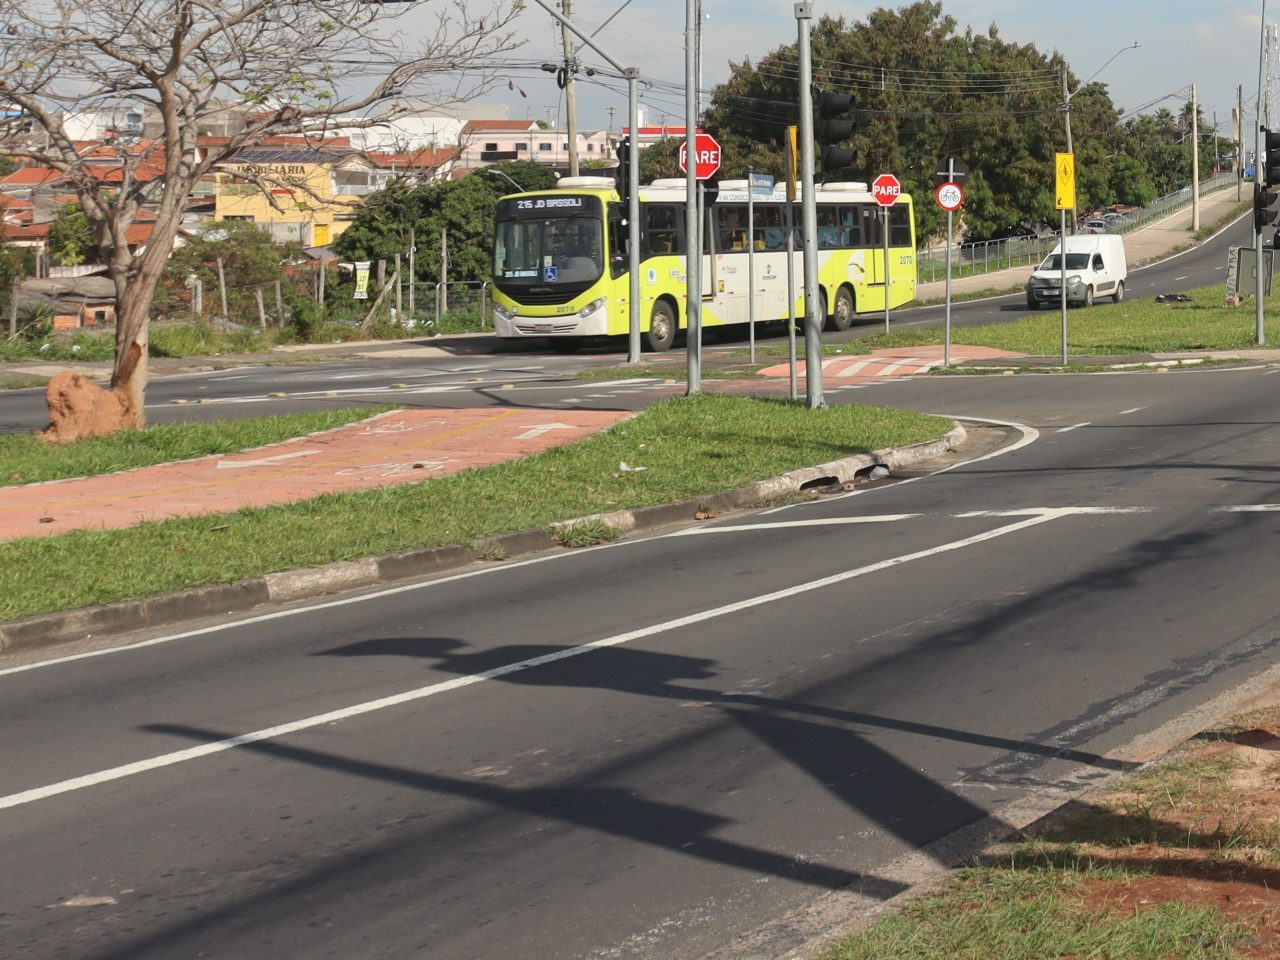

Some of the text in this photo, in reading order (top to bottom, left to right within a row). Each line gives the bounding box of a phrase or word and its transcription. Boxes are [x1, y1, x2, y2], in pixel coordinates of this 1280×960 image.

[874, 185, 899, 196] PARE
[517, 198, 582, 209] 215 JD BASSOLI
[900, 256, 913, 265] 2070
